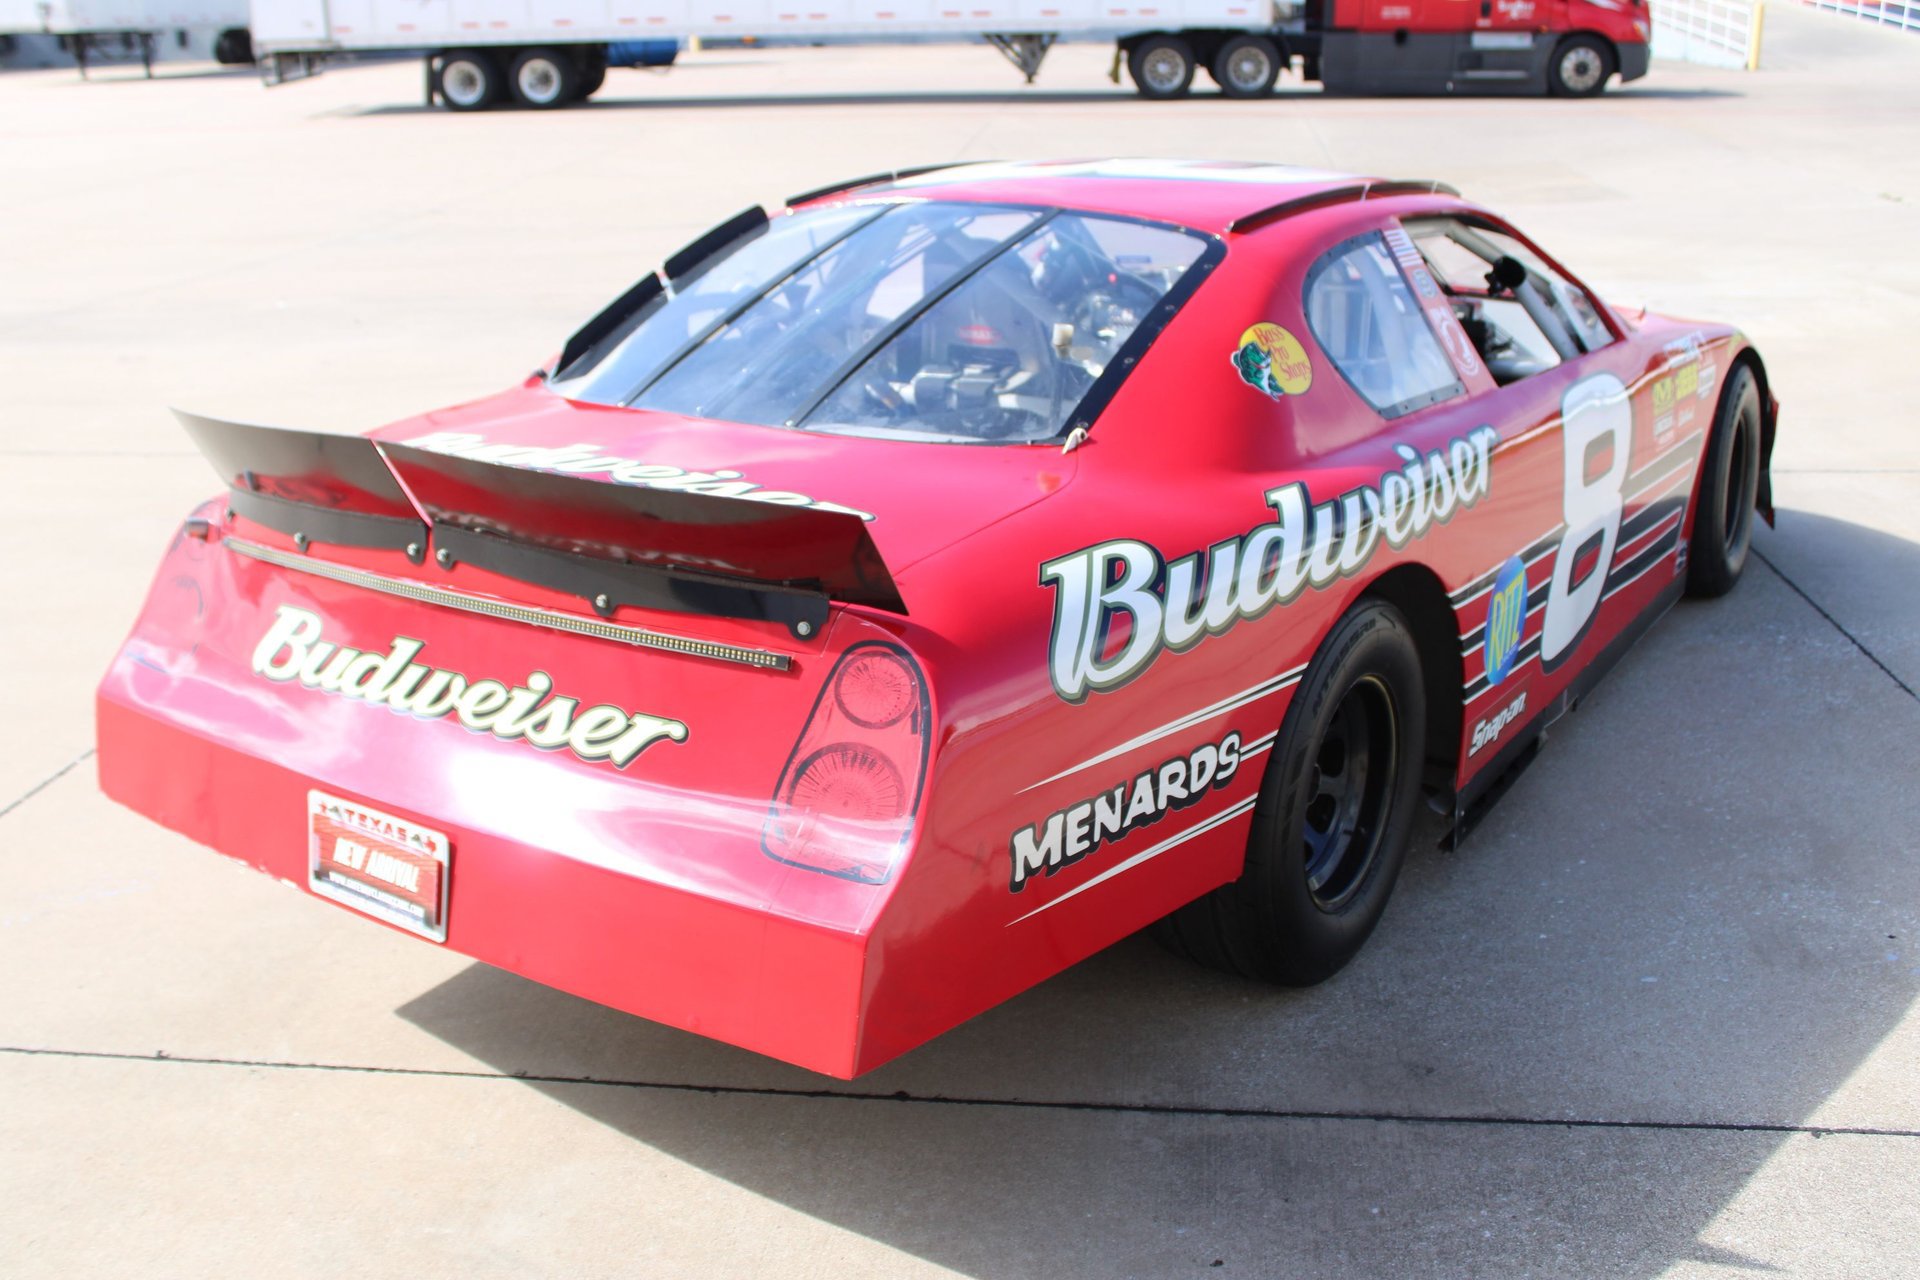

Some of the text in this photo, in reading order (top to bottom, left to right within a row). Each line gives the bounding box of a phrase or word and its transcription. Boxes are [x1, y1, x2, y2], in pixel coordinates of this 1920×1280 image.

[1038, 423, 1497, 704] Budweiser
[1540, 370, 1632, 674] 8
[251, 604, 689, 769] Budweiser
[1468, 691, 1528, 758] Snap-on
[344, 808, 408, 841] TEXAS
[1009, 730, 1242, 894] MENARDS
